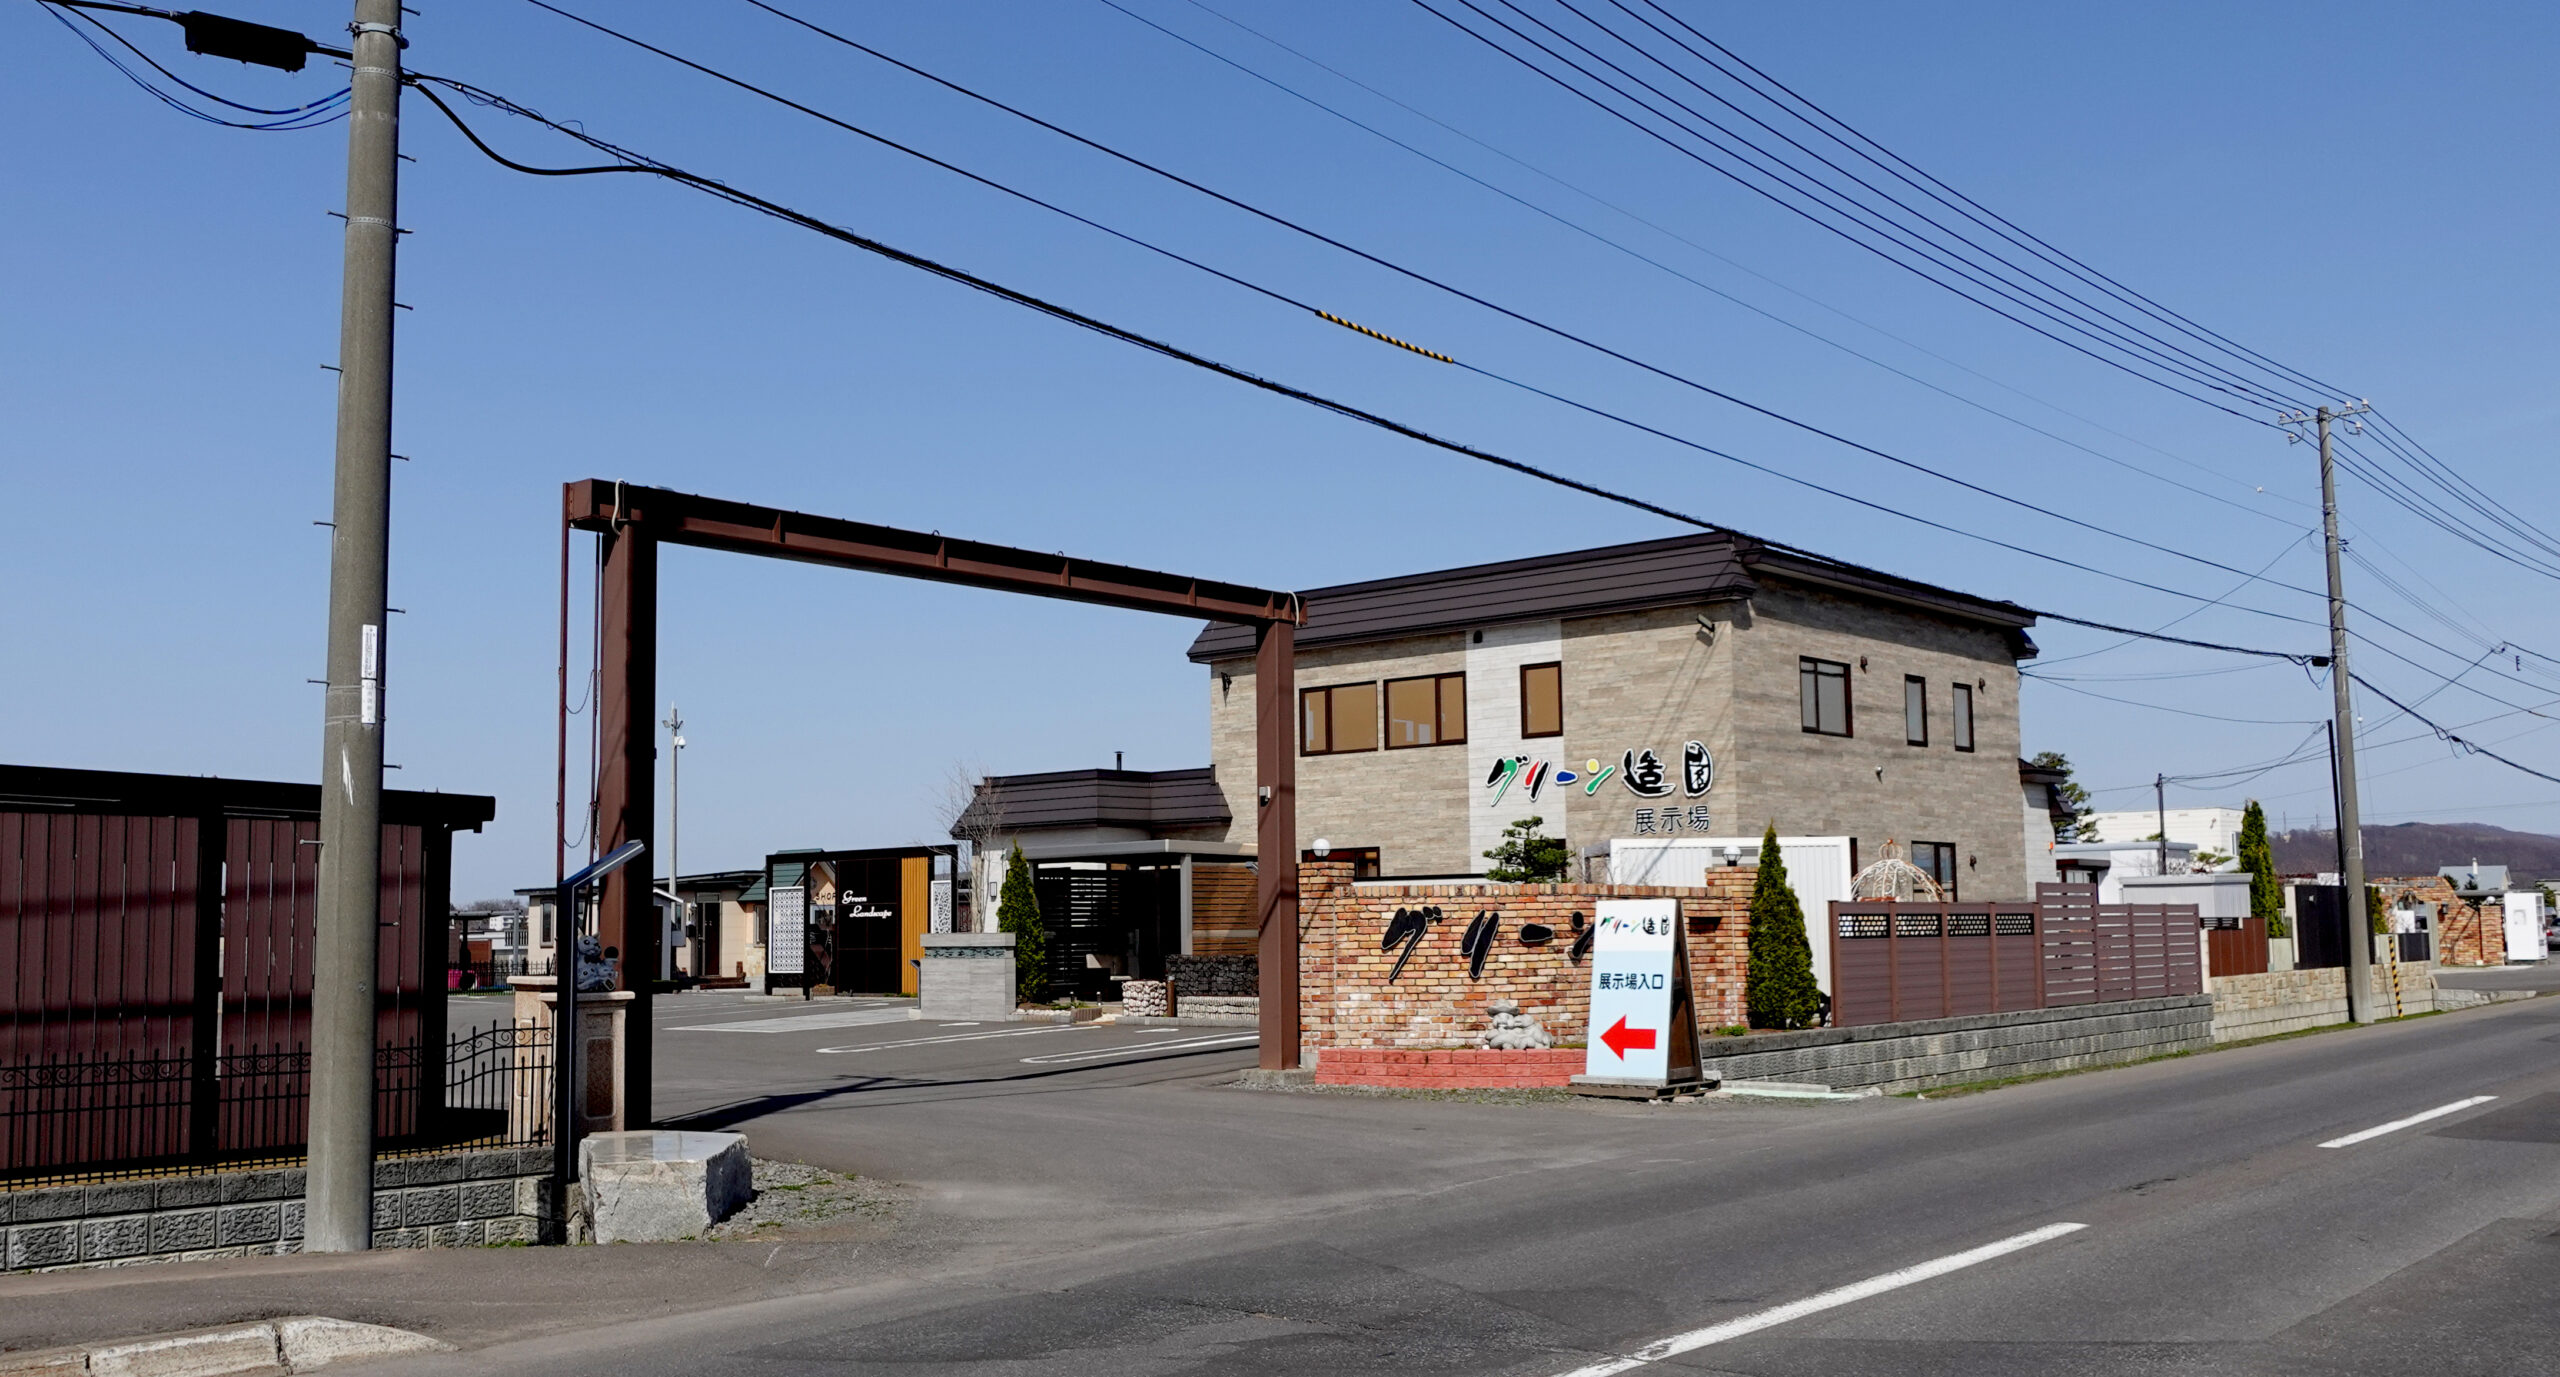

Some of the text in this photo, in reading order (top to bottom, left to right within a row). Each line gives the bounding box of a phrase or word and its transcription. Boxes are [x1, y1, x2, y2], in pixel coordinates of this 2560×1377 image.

[1486, 740, 1714, 807] グリーン造園
[1633, 805, 1711, 835] 展示場
[842, 890, 867, 904] Green
[849, 905, 892, 919] Landscape
[1598, 972, 1664, 990] 展示場入口
